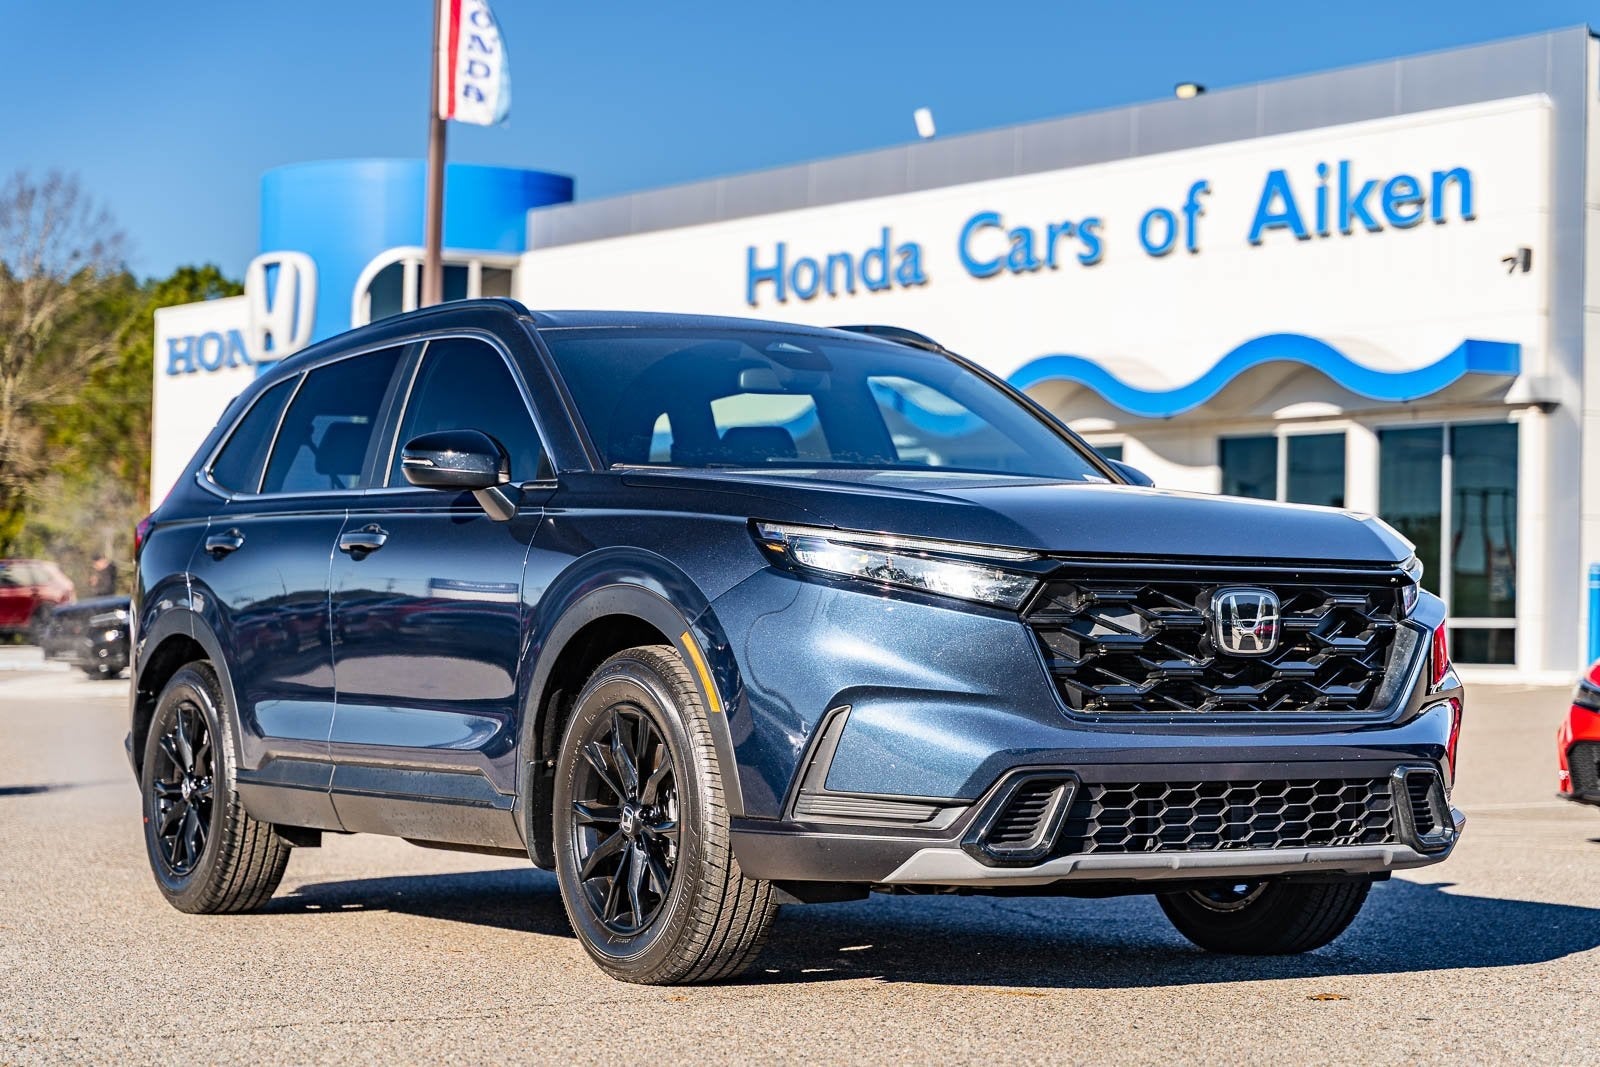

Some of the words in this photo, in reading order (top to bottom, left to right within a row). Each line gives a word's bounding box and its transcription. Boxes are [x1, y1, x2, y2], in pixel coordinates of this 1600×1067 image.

[462, 0, 497, 102] ONDA
[745, 226, 927, 306] Honda
[958, 211, 1103, 278] Cars
[1138, 179, 1209, 257] of
[1247, 160, 1476, 246] Aiken
[165, 329, 252, 375] HON
